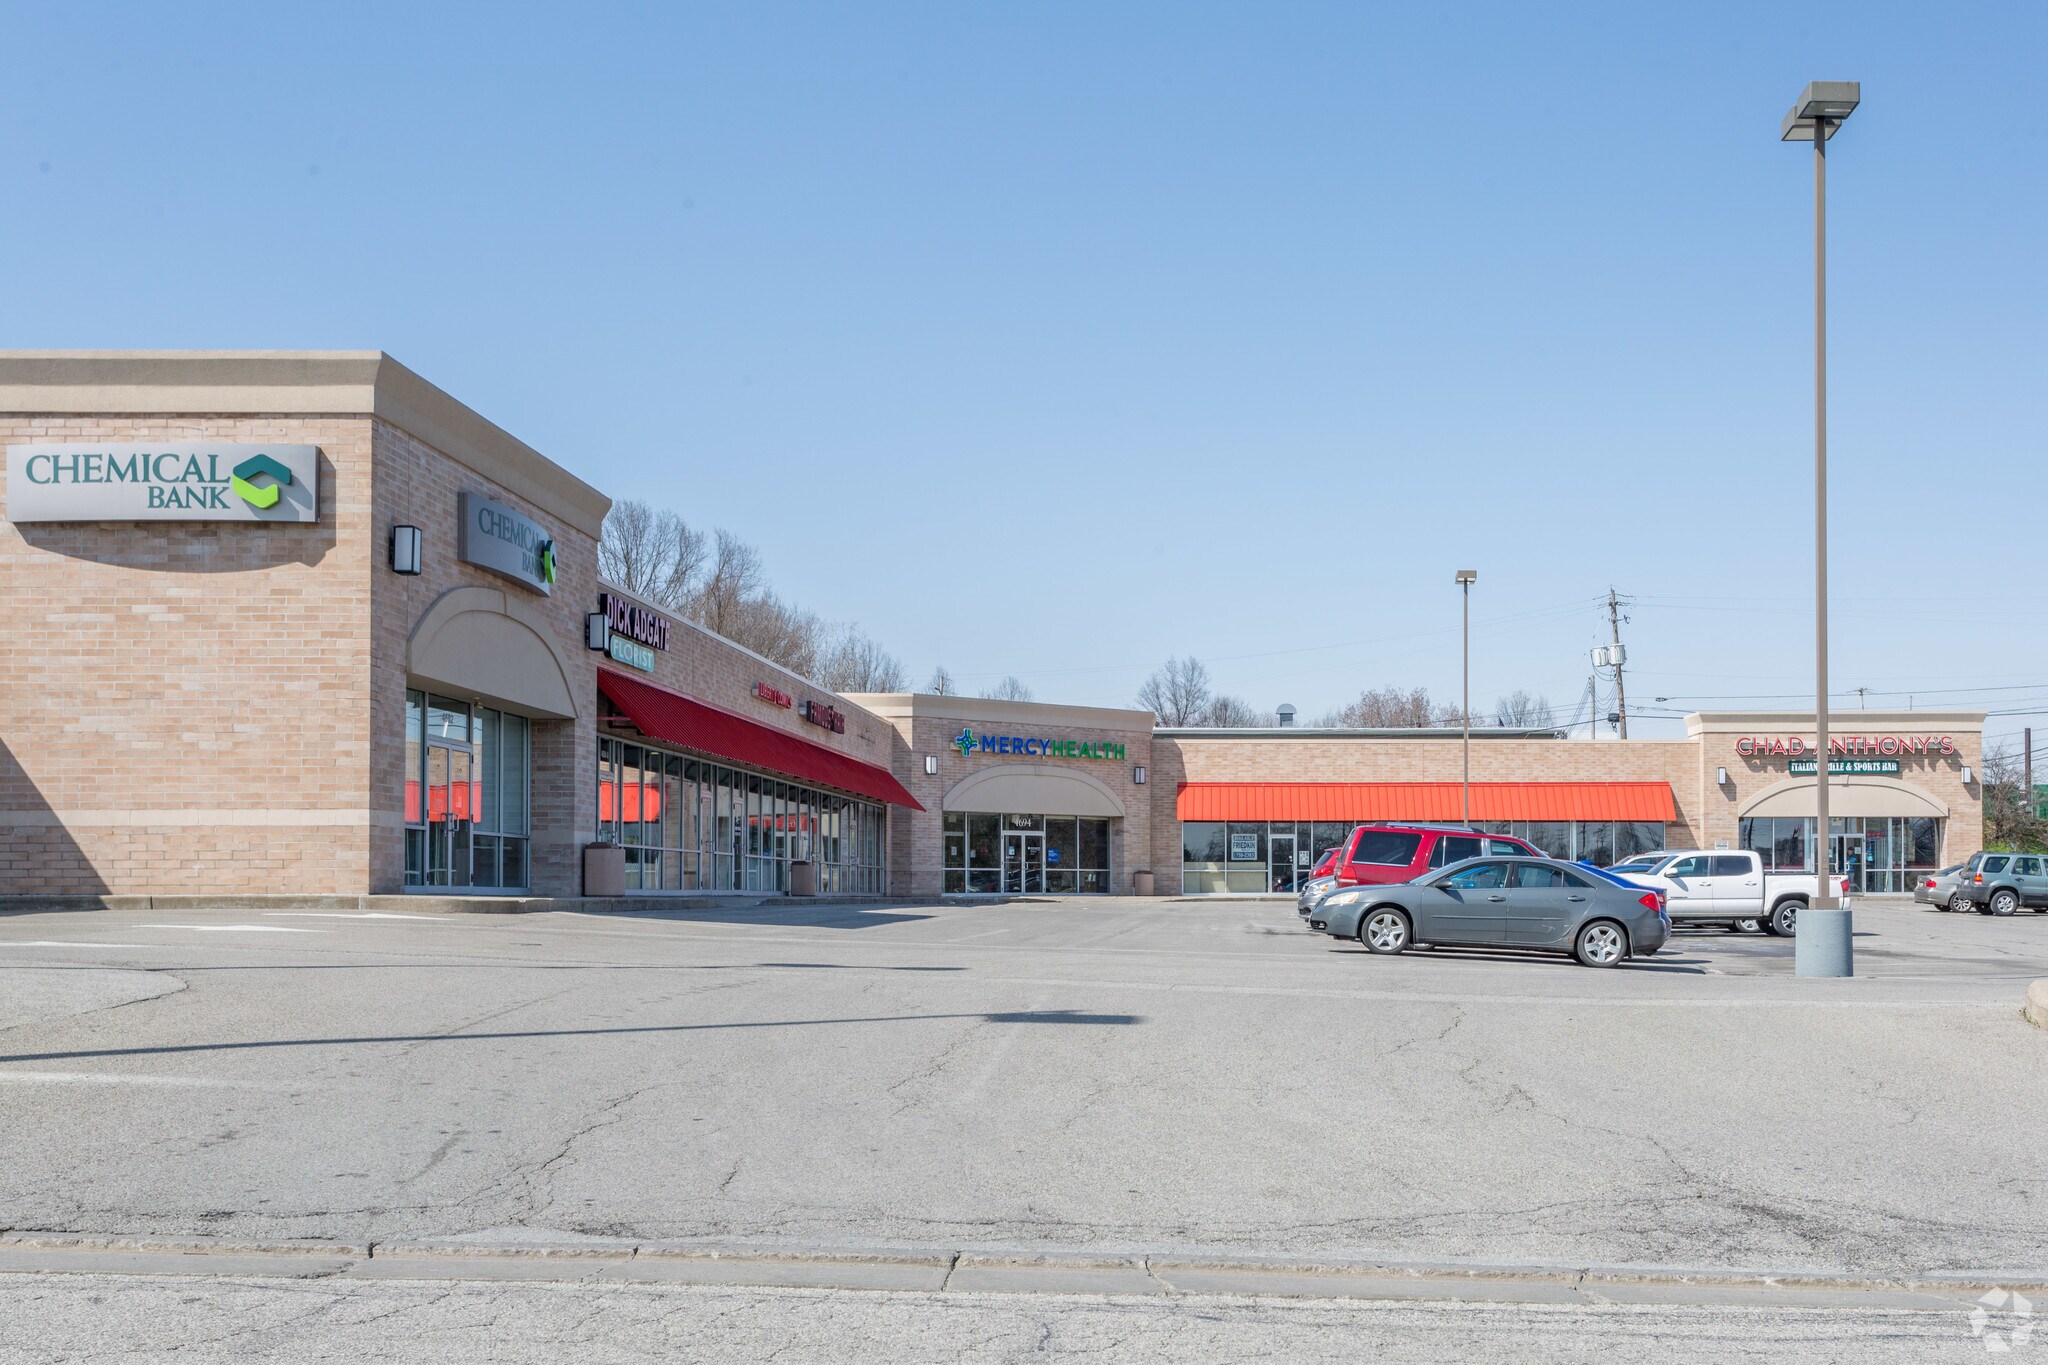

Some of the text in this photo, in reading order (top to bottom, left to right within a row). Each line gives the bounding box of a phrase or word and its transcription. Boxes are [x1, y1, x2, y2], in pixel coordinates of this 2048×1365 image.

[25, 453, 231, 485] CHEMICAL
[147, 486, 231, 509] BANK
[478, 507, 542, 557] CHEMICAL
[607, 594, 671, 652] DICK ADGATE
[613, 639, 654, 668] FLORIST
[1735, 737, 1805, 756] CHAD
[1845, 762, 1852, 772] &
[1853, 761, 1881, 772] SPORTS
[1882, 761, 1898, 772] BAR
